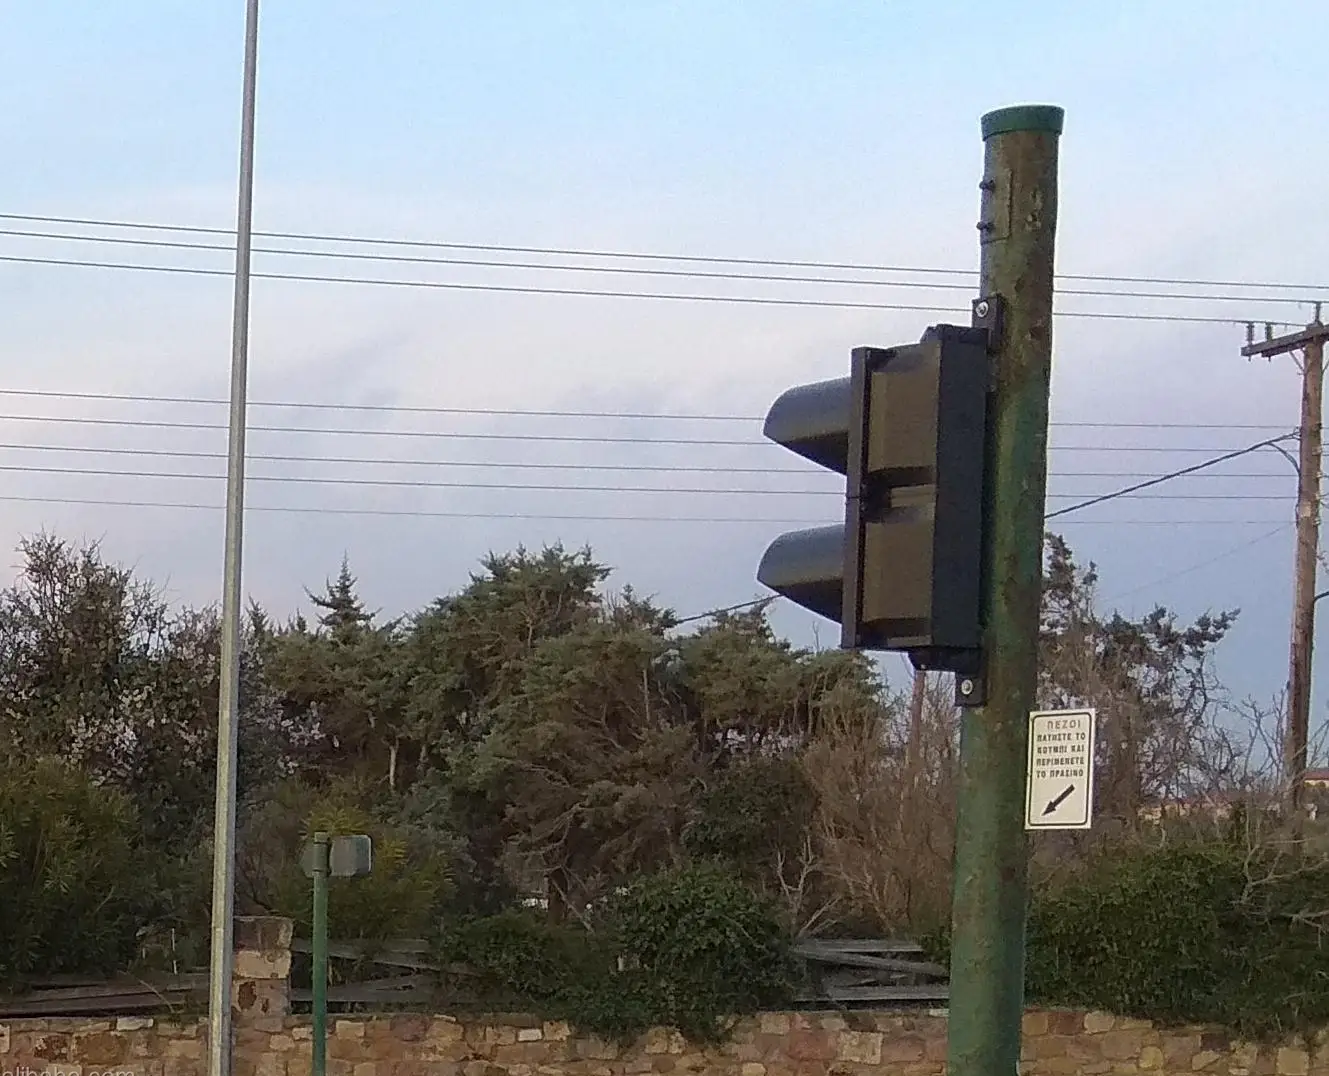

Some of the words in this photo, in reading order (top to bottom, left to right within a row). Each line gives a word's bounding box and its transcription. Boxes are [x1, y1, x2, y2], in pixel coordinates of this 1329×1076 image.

[1047, 720, 1081, 729] ΠΕΖΟΙ
[1076, 732, 1086, 740] ΤΟ
[1071, 744, 1085, 752] ΚΑΙ
[1036, 770, 1046, 778] ΤΟ
